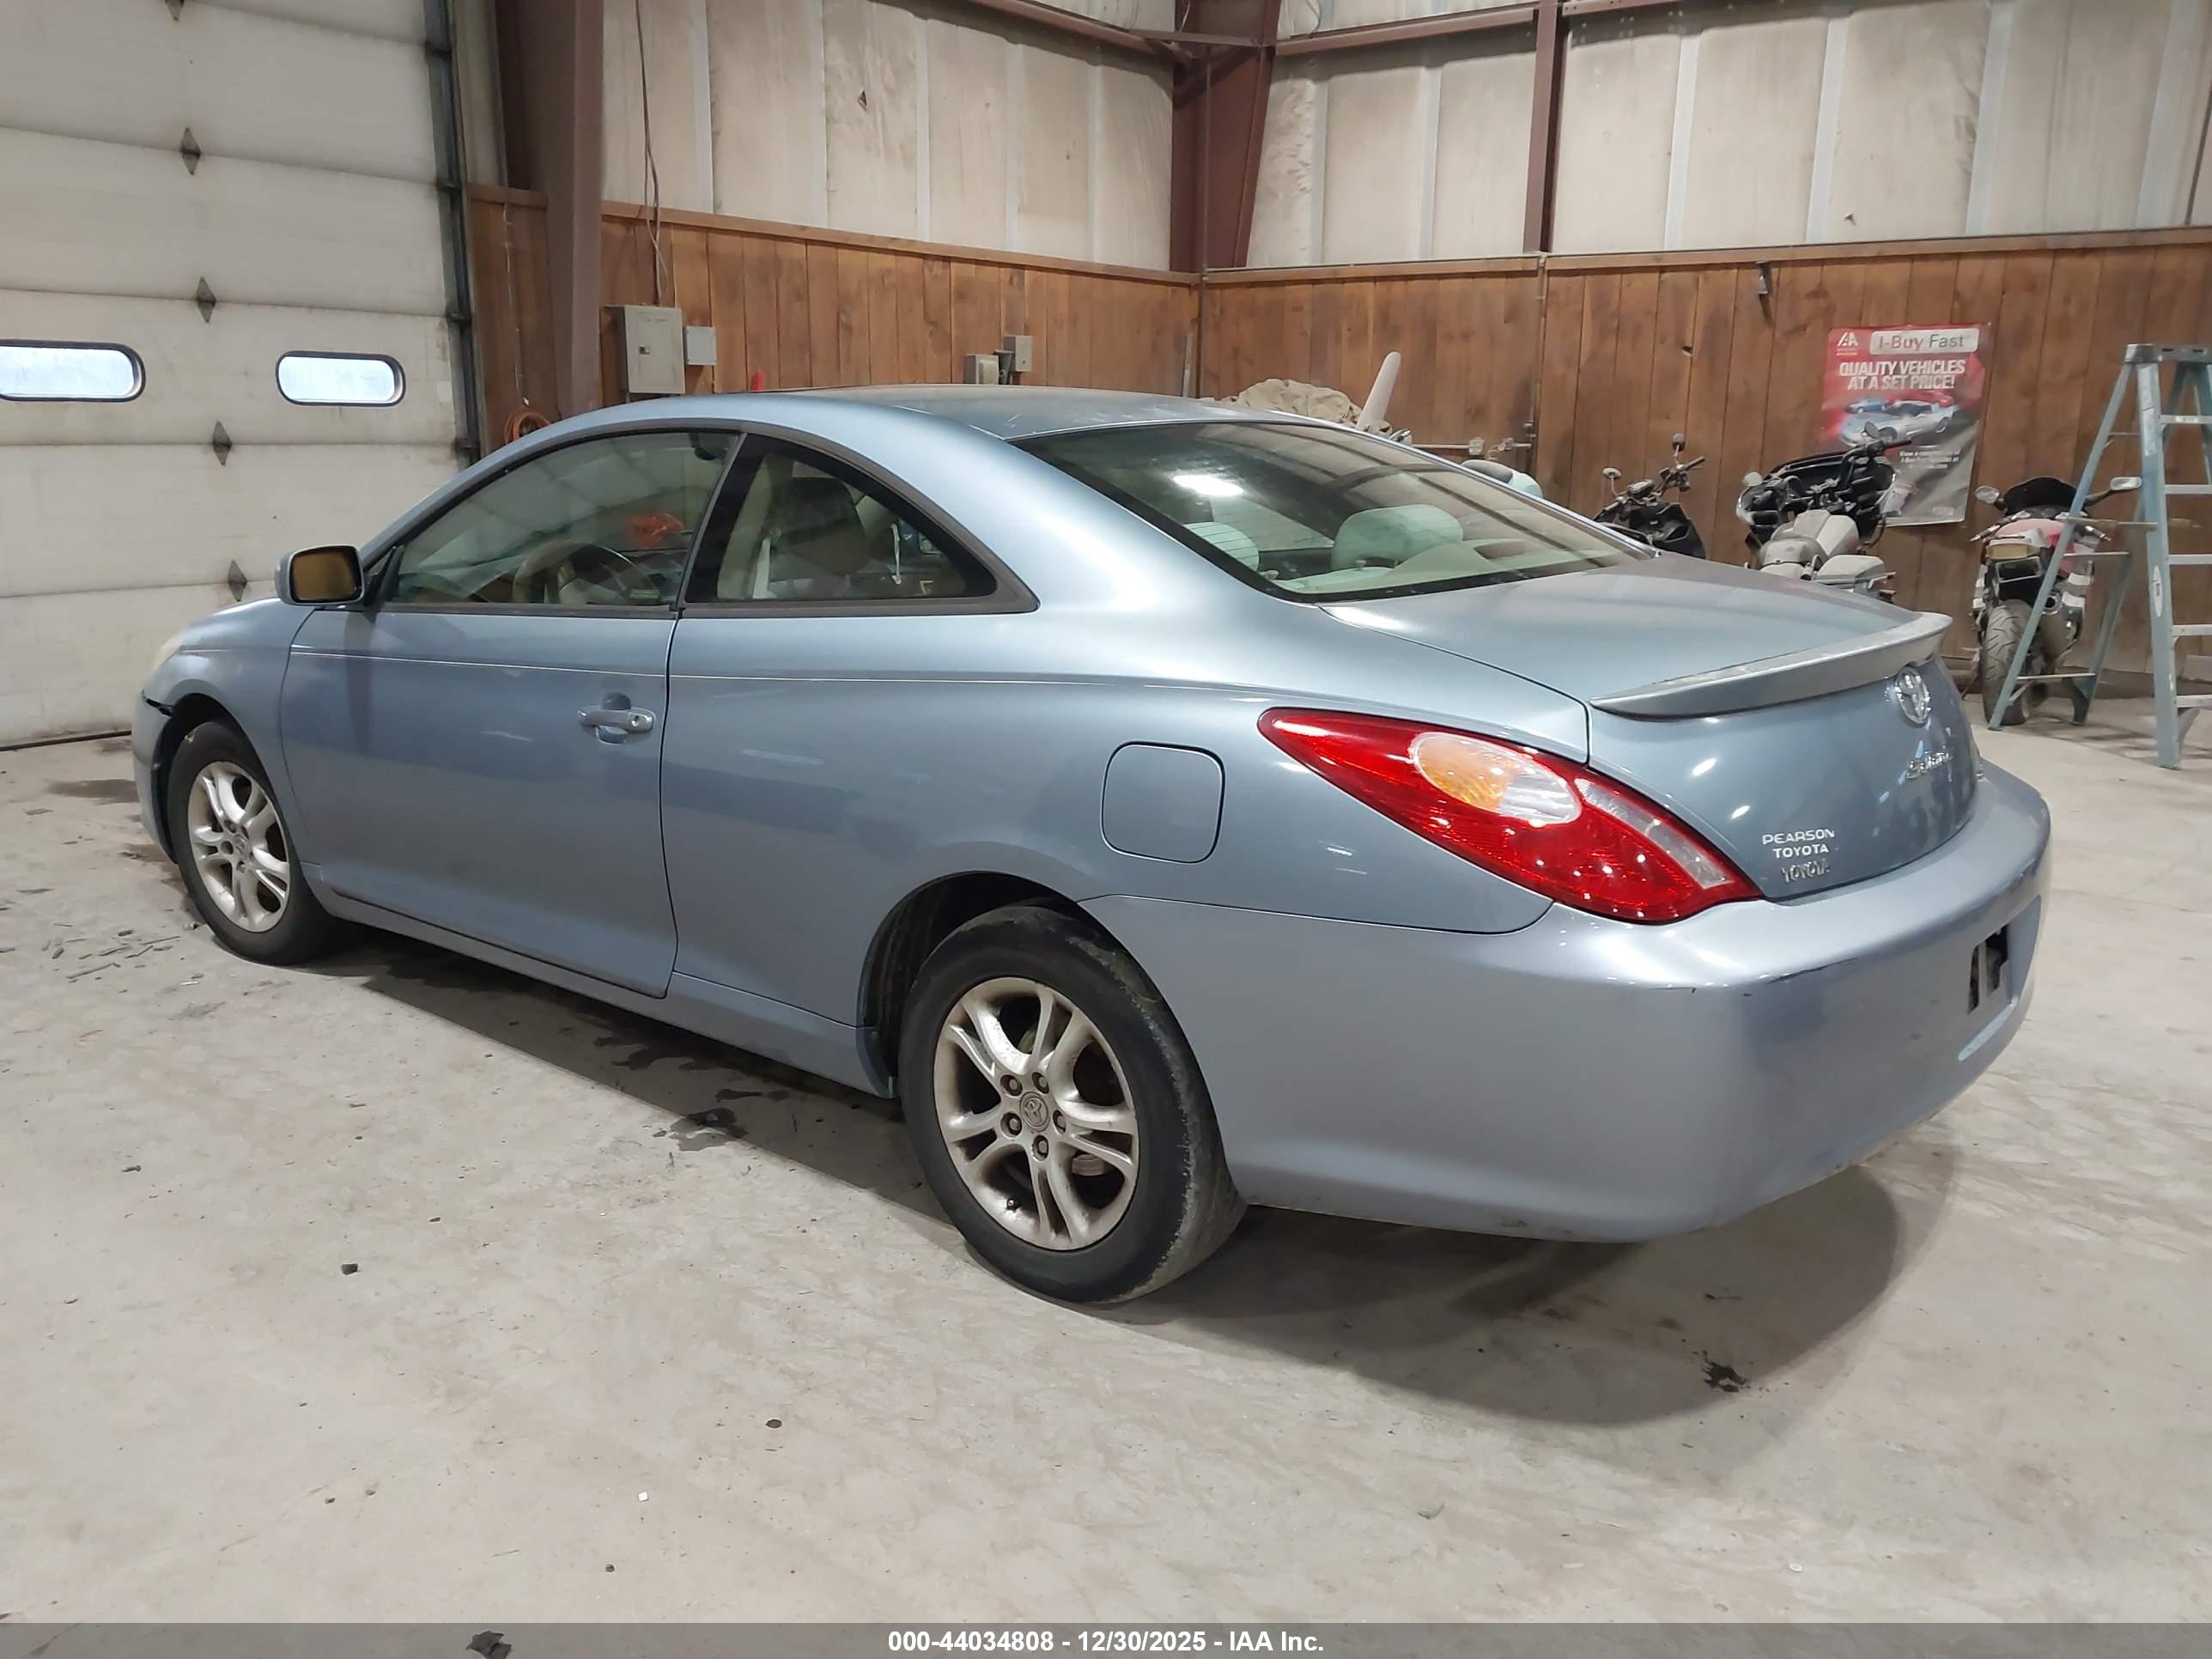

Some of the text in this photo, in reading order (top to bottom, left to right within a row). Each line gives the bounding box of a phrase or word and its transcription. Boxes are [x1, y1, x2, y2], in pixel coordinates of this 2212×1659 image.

[1878, 333, 1965, 351] I-Buy Fast
[1839, 359, 1966, 376] QUALITY VEHICLES
[1847, 374, 1956, 390] AT A SET PRICE!
[1762, 828, 1835, 846] PEARSON
[1772, 843, 1830, 859] TOYOTA
